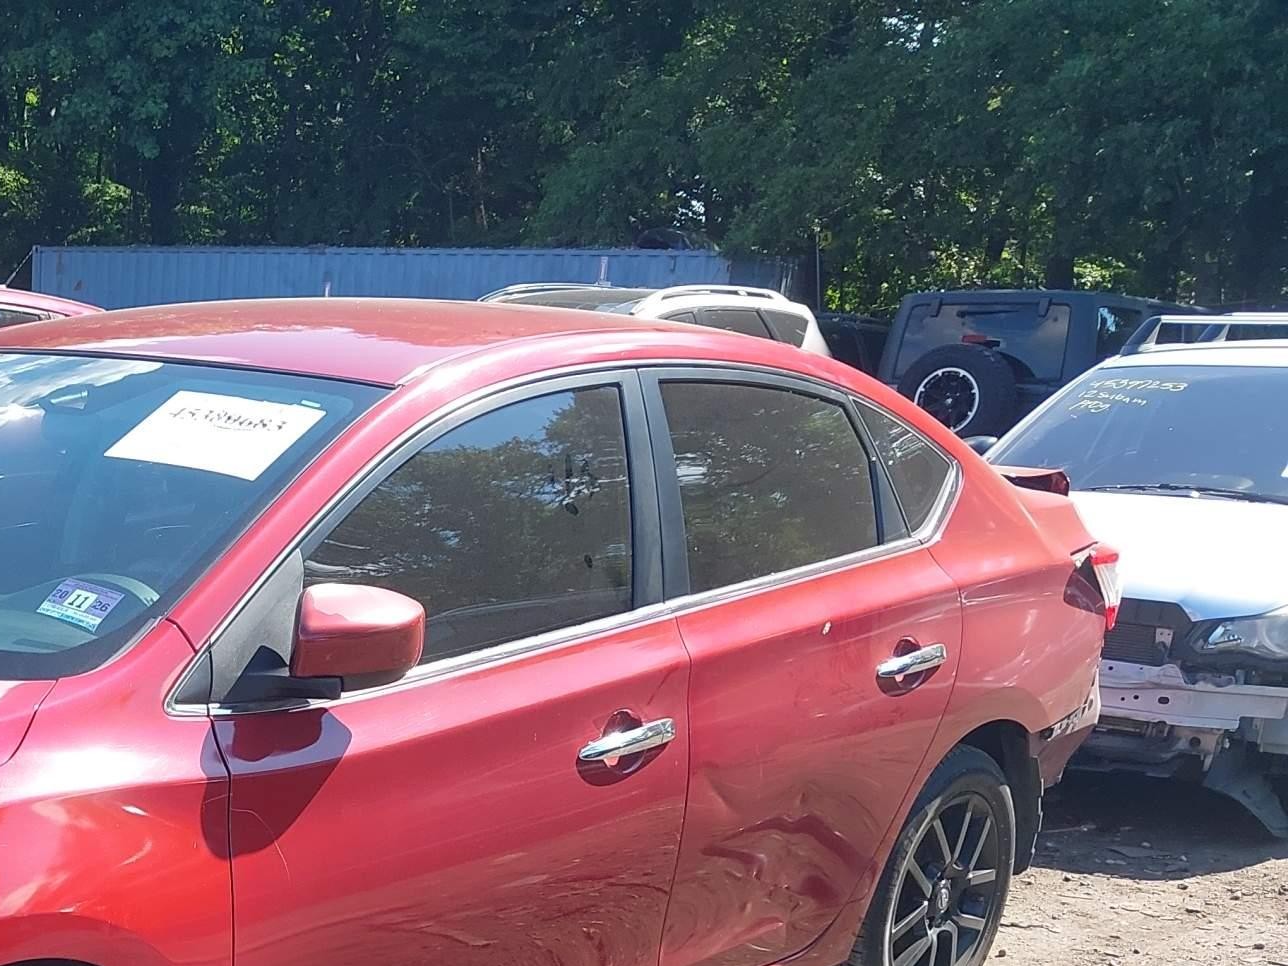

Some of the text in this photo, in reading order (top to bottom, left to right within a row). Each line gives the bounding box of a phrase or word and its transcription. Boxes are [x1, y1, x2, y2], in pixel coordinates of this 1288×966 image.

[52, 588, 70, 600] 20
[68, 594, 90, 609] 11
[91, 600, 111, 613] 26
